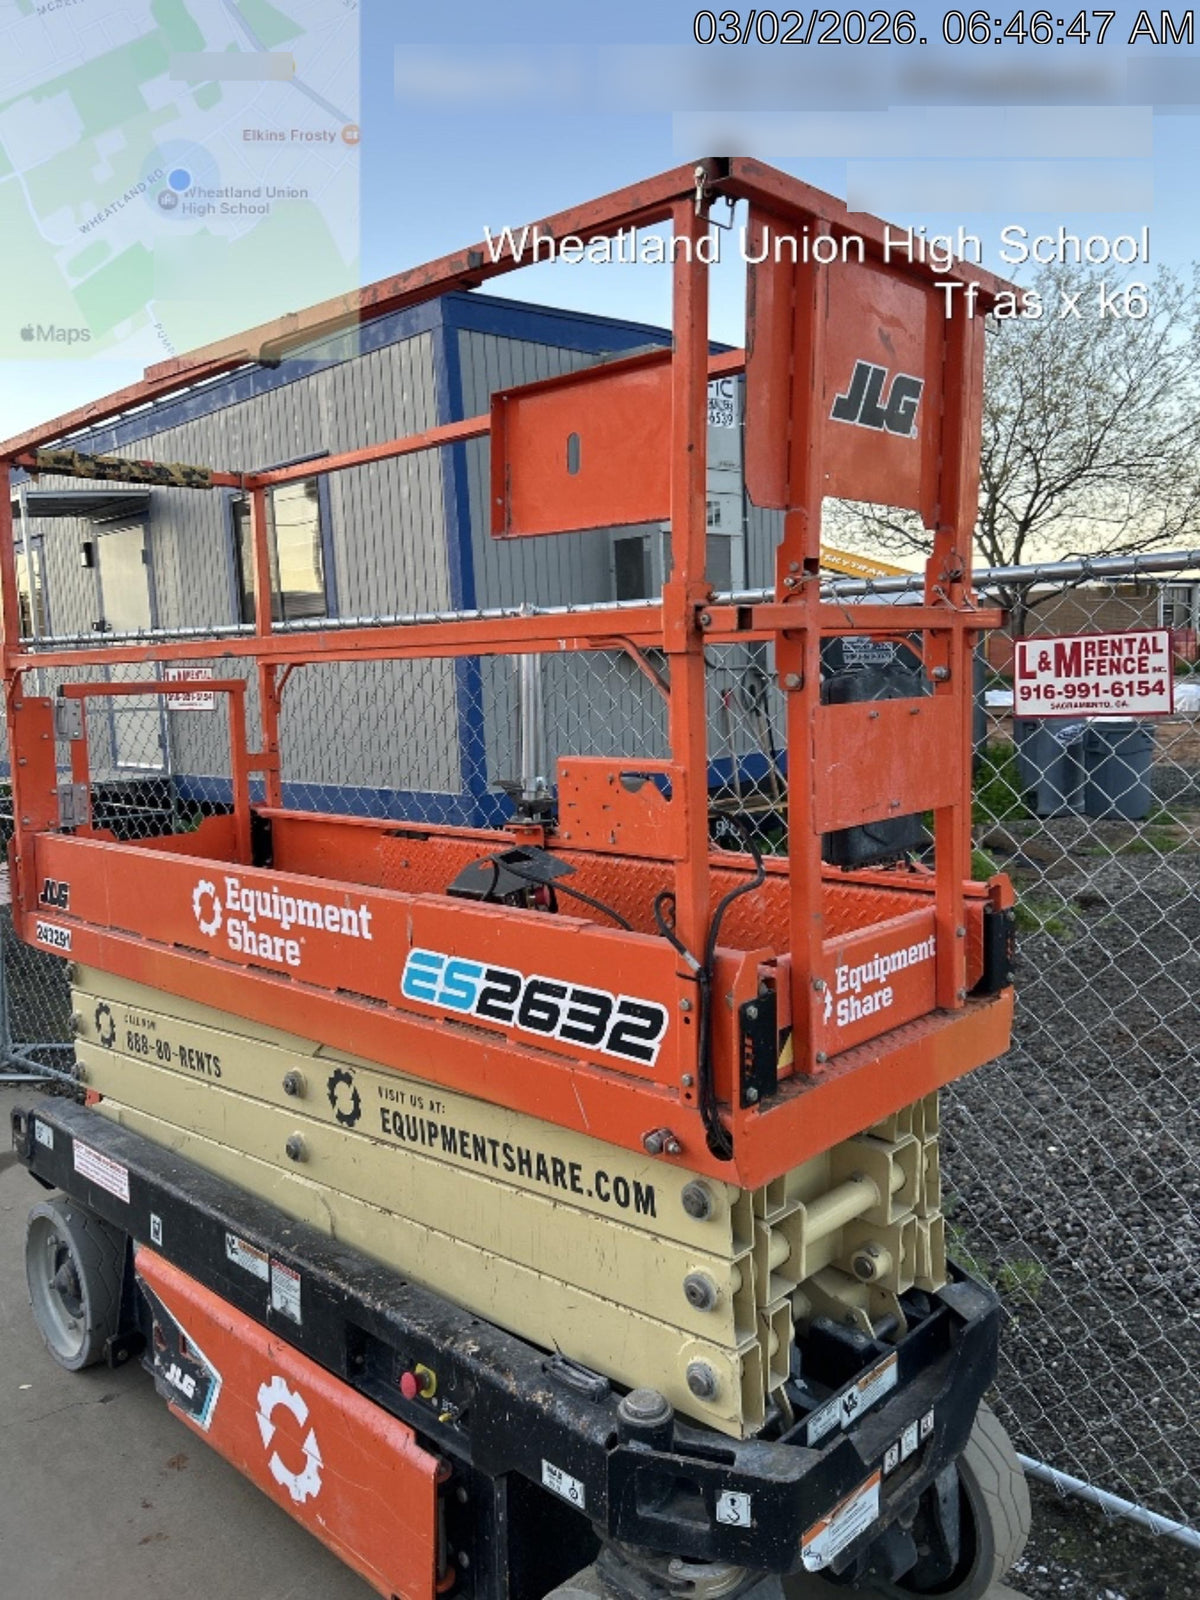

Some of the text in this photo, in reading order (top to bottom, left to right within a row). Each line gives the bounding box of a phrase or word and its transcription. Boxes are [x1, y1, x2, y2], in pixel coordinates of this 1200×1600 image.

[829, 359, 926, 441] JLG
[1084, 636, 1163, 658] RENTAL
[1084, 656, 1149, 676] FENCE
[1019, 679, 1165, 701] 916-991-6154
[39, 878, 70, 911] JLG
[224, 876, 373, 940] Equipment
[226, 918, 301, 967] Share
[836, 934, 936, 994] Equipment
[401, 947, 669, 1067] ES2632
[836, 984, 893, 1027] Share
[127, 1030, 222, 1078] 888-80-RENTS
[378, 1085, 446, 1114] VISIT US AT:
[380, 1106, 657, 1219] EQUIPMENTSHARE.COM
[164, 1362, 197, 1399] JLG
